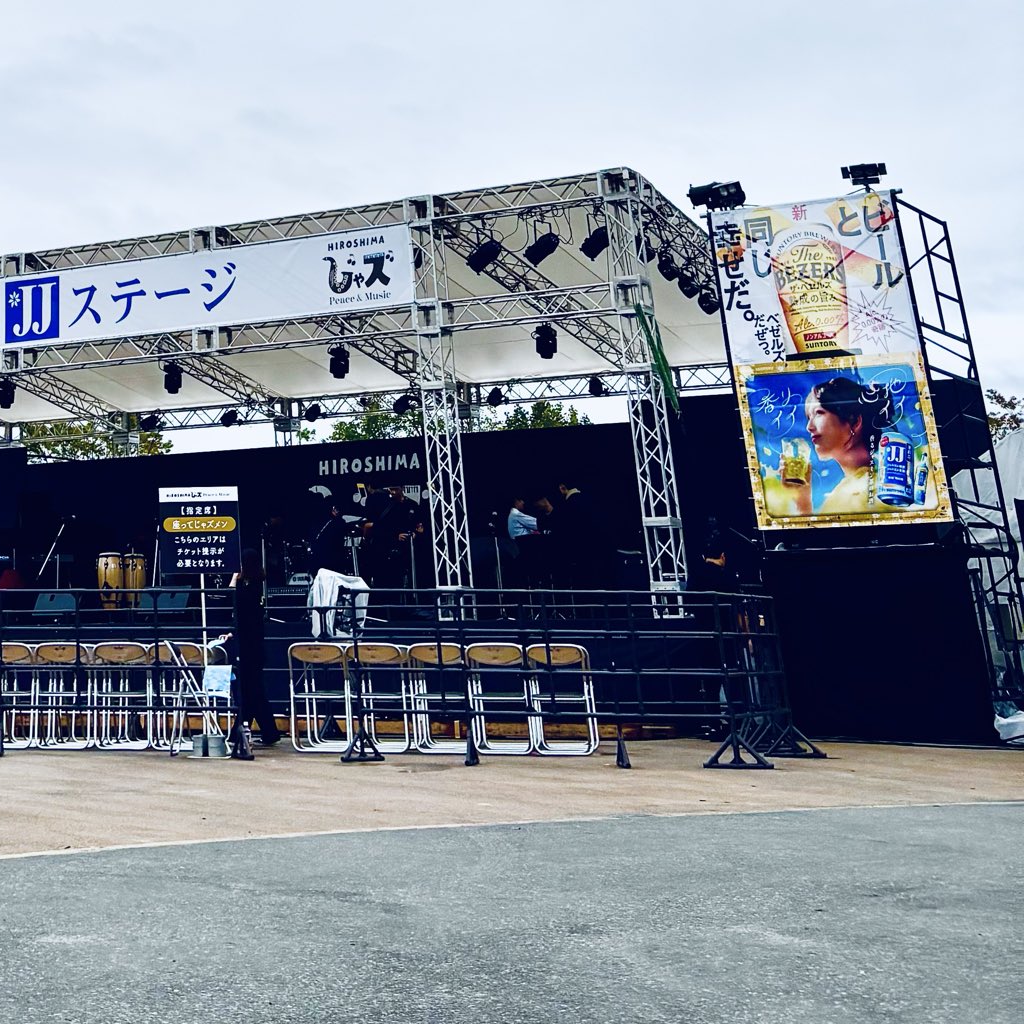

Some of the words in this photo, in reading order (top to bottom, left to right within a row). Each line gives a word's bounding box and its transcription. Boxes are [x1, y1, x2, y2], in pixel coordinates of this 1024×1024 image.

[792, 204, 806, 221] 新
[837, 206, 861, 236] と
[327, 235, 385, 252] HIROSHIMA
[744, 216, 774, 278] 同じ
[791, 243, 823, 263] The
[863, 198, 904, 290] ビール
[322, 250, 394, 294] じゃズ
[715, 221, 755, 322] 幸せだ。
[68, 262, 237, 328] ステージ
[329, 295, 355, 306] Peace
[356, 294, 362, 302] &
[364, 290, 392, 302] Music
[754, 314, 770, 355] だぜっ。
[766, 313, 786, 362] ベゼルズ
[805, 340, 837, 349] SUNTORY
[806, 332, 834, 340] ノンアルコ
[319, 453, 420, 476] HIROSHIMA
[172, 520, 228, 530] 座ってじゃズメン
[177, 547, 224, 556] チケット提示が
[176, 559, 224, 568] 必要となります。
